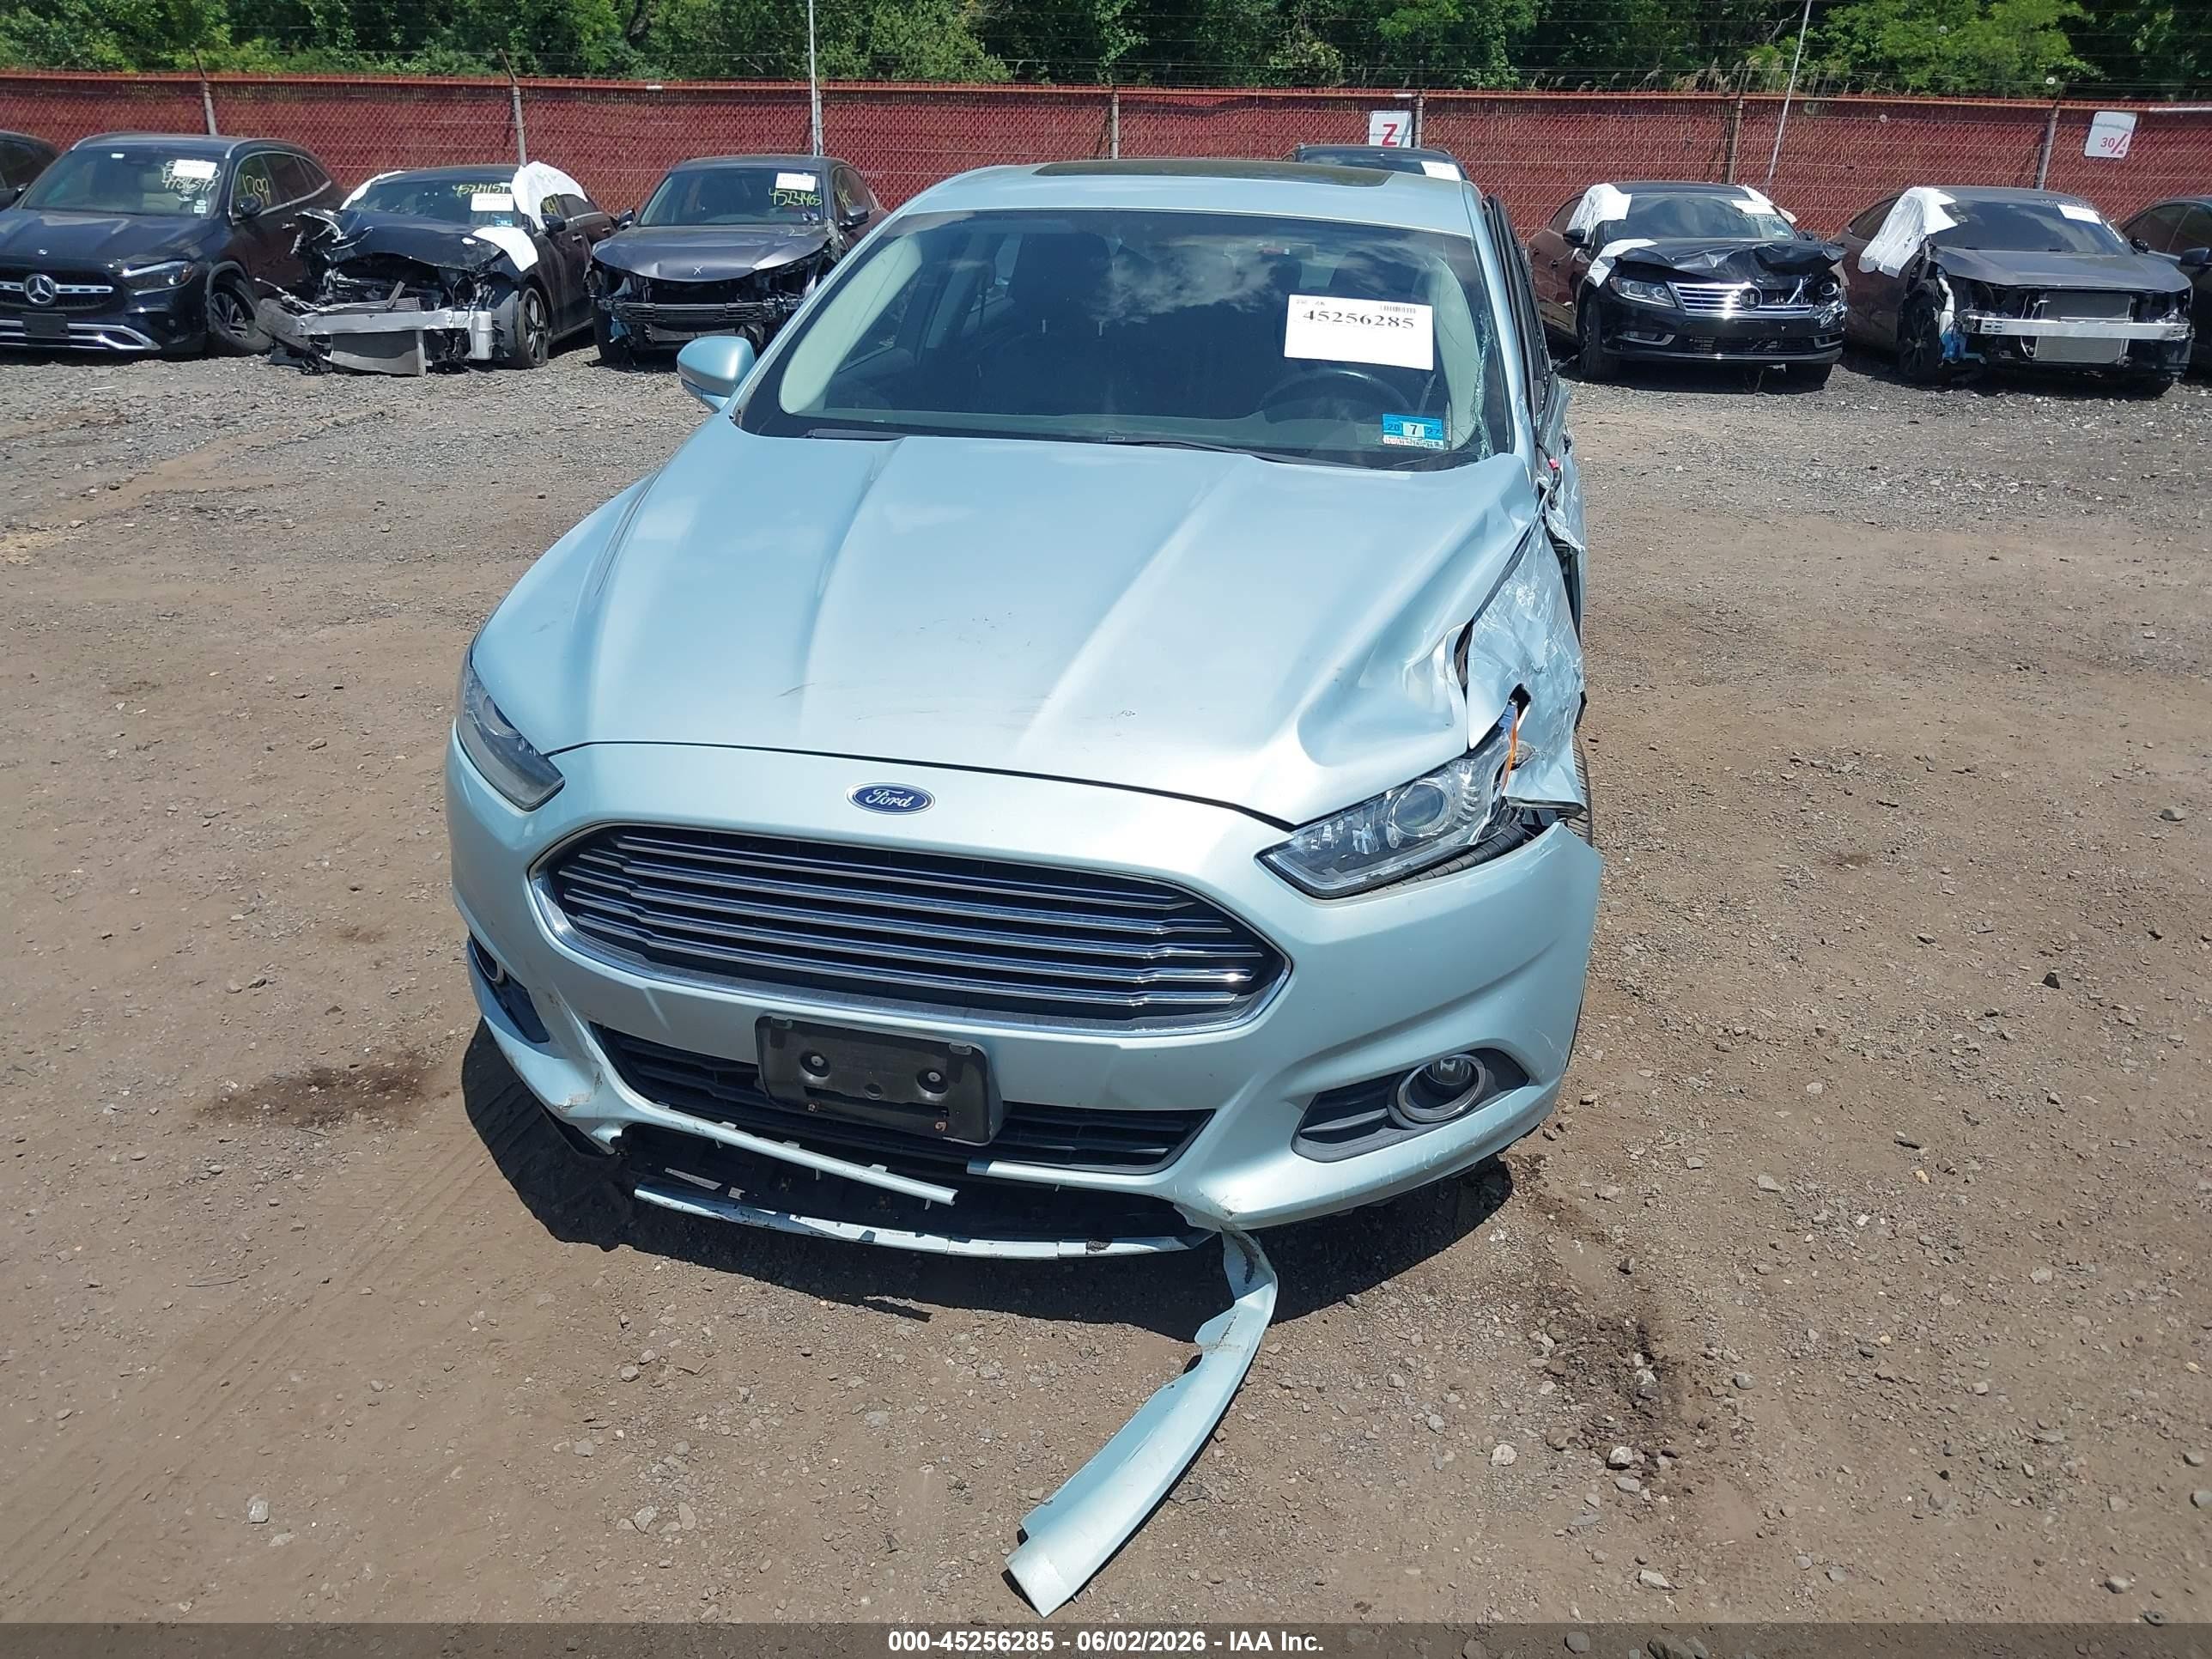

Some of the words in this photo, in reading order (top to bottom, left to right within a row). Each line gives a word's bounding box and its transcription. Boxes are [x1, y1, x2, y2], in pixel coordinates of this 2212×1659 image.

[1382, 123, 1398, 146] Z
[1303, 310, 1415, 329] 45256285
[1410, 424, 1418, 434] 7
[865, 788, 915, 807] Ford
